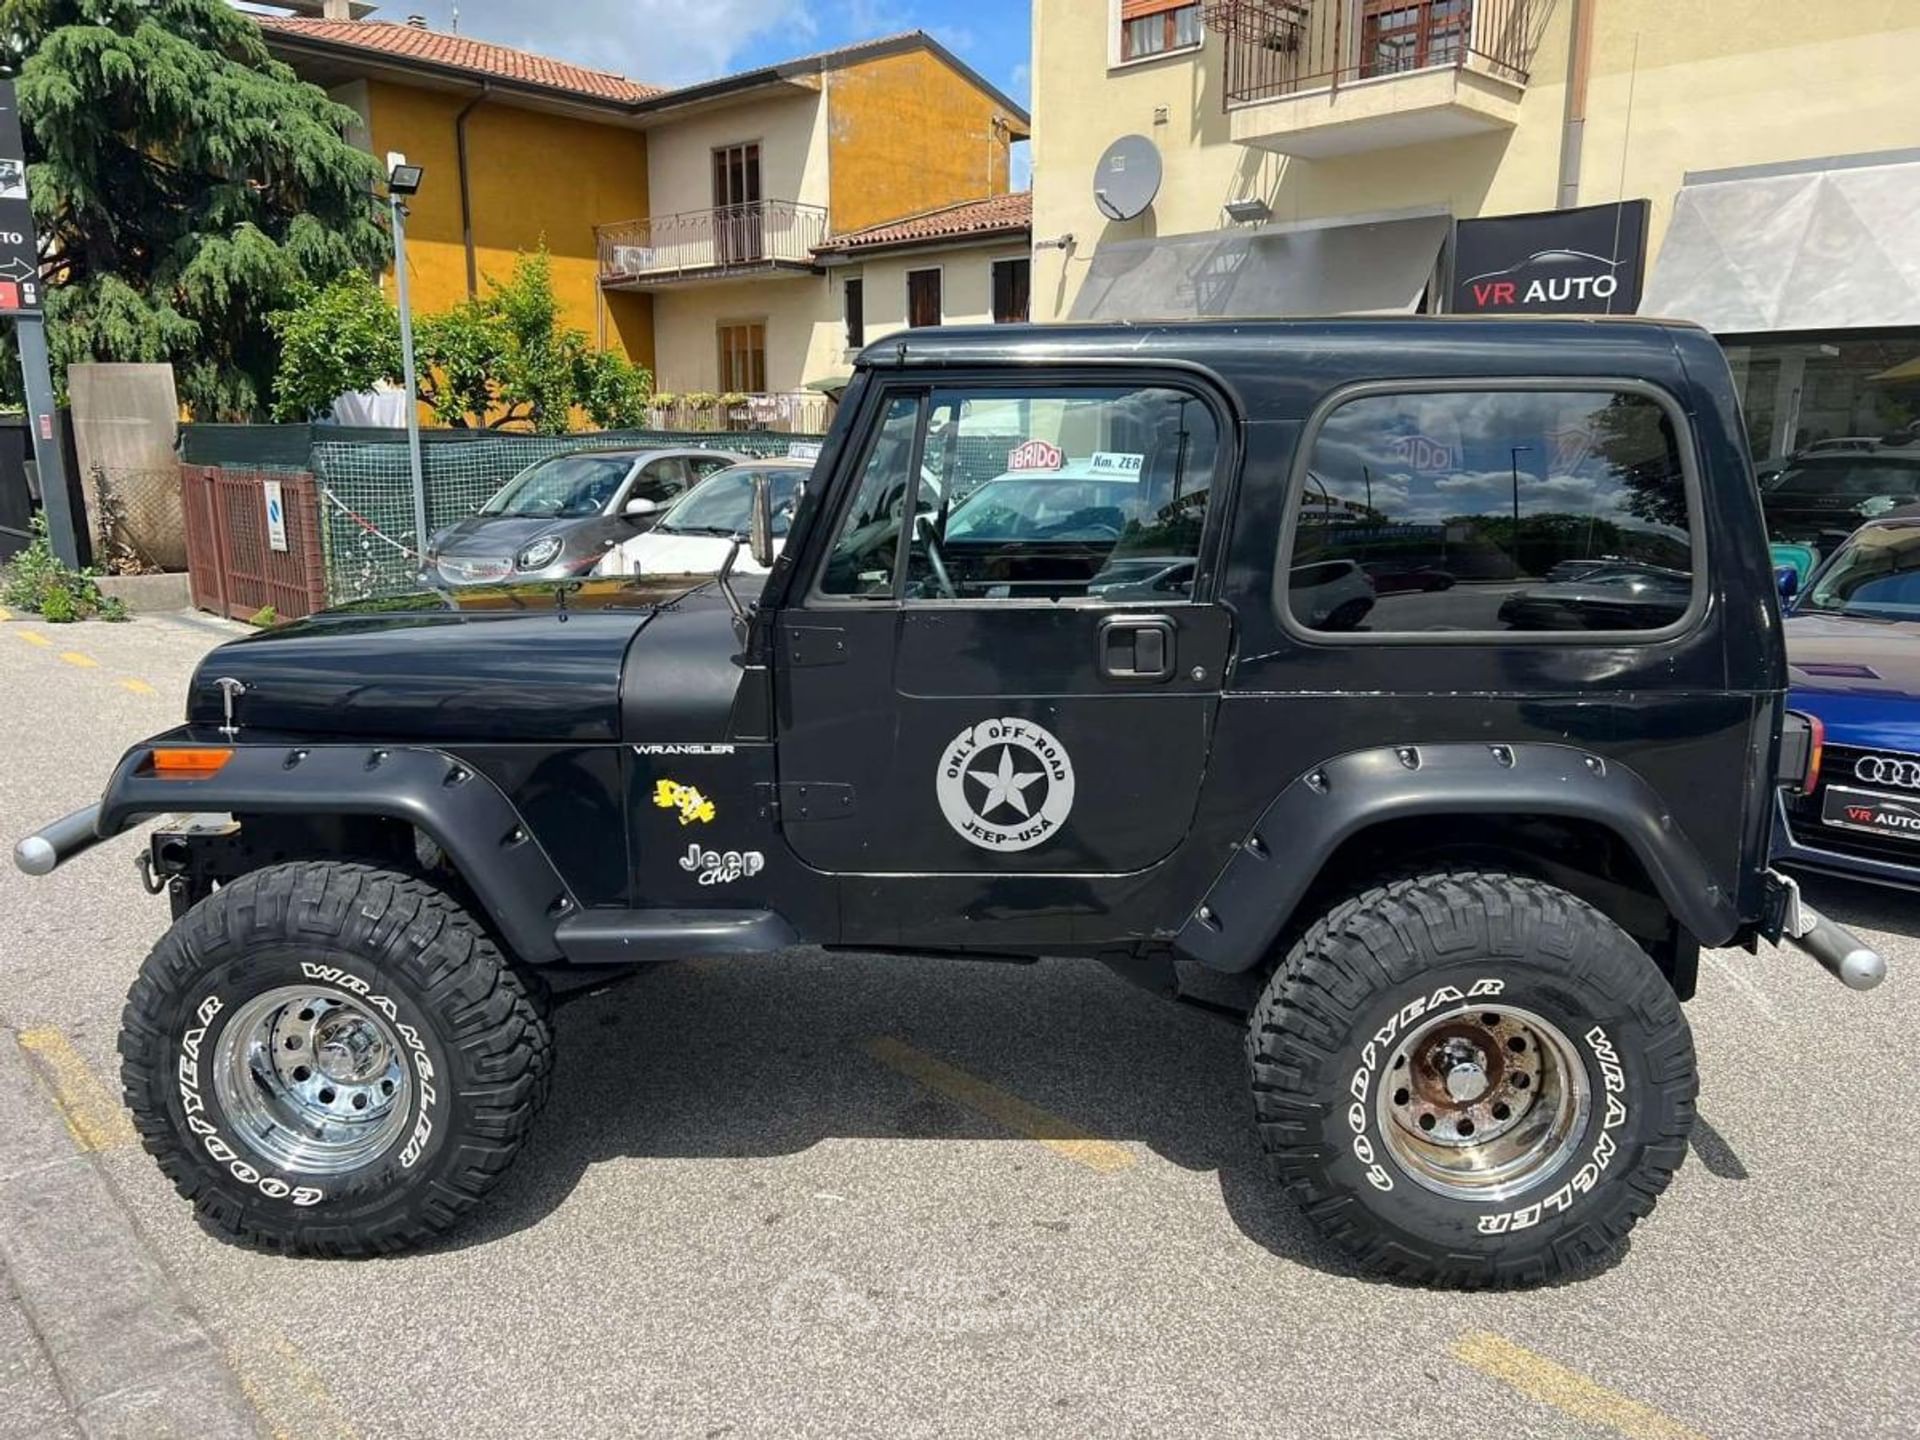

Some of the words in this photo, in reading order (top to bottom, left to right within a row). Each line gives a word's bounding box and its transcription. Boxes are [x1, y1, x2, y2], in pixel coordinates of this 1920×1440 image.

[1473, 283, 1515, 306] VR
[1523, 275, 1617, 303] AUTO
[633, 745, 735, 755] WRANGLER
[947, 736, 976, 779] ONLY
[989, 726, 1065, 781] OFF-ROAD
[962, 819, 1054, 844] JEEP-USA
[1848, 808, 1872, 821] VR
[1875, 813, 1920, 829] AUTO
[678, 843, 764, 876] Jeep
[301, 962, 435, 1168] WRANGLER
[1349, 979, 1504, 1191] GOODYEAR
[179, 996, 322, 1206] GOODYEAR
[1478, 1026, 1626, 1234] WRANGLER
